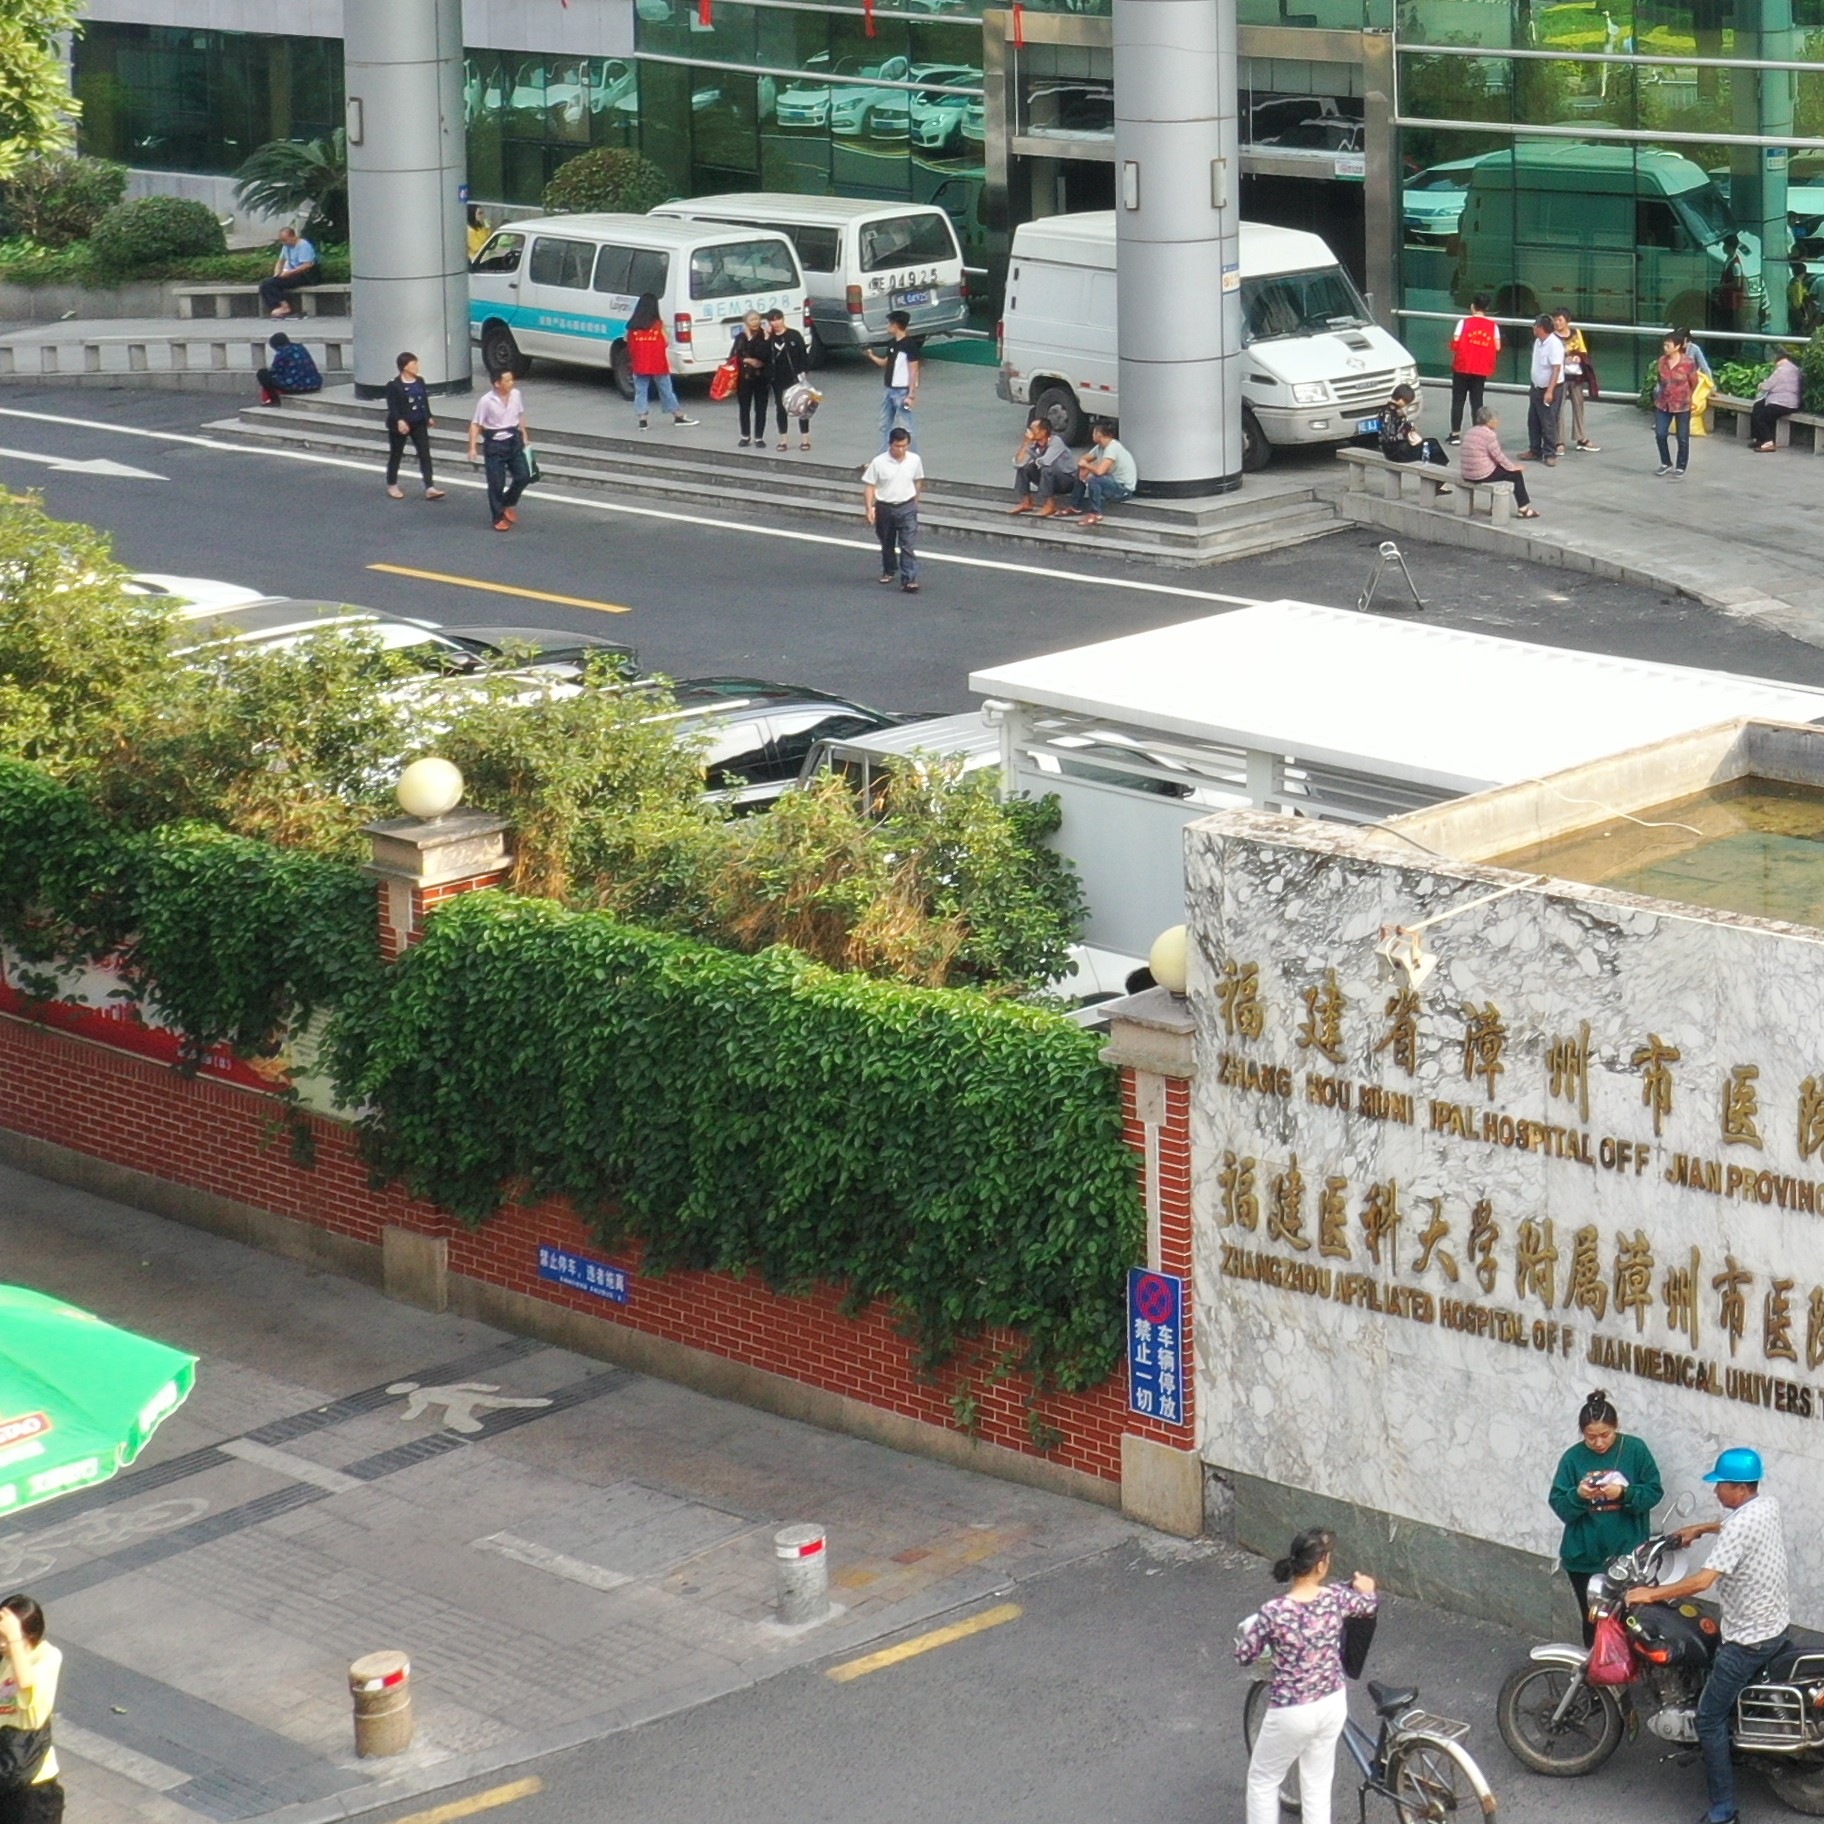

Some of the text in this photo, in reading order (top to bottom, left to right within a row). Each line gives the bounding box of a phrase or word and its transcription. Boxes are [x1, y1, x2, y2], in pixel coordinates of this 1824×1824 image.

[1484, 1111, 1596, 1165] HOSPITAL
[1134, 1318, 1153, 1412] 禁止一切
[1220, 1244, 1332, 1299] ZHANGZHOU
[1439, 1296, 1529, 1348] HOSPITAL
[1634, 1344, 1724, 1396] MEDICAL
[1157, 1325, 1176, 1419] 车辆停放
